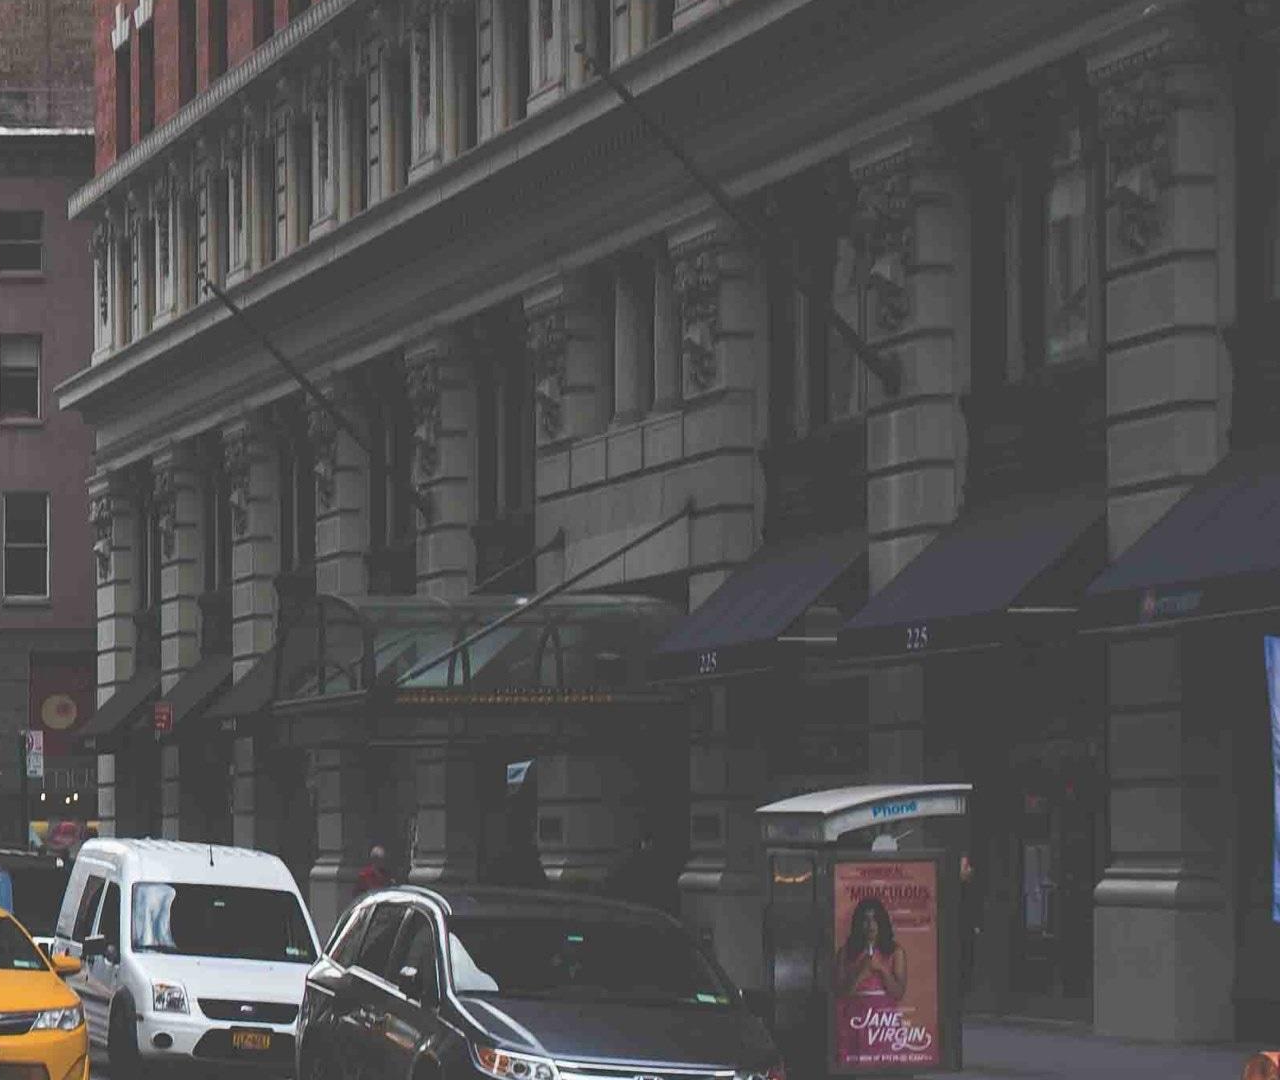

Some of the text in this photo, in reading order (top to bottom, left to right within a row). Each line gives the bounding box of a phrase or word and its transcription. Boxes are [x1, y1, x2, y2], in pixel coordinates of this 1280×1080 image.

[905, 627, 928, 649] 225
[699, 651, 717, 673] 225
[872, 800, 917, 817] Phone
[849, 1007, 905, 1029] JANE
[867, 1026, 932, 1051] VIRGIN
